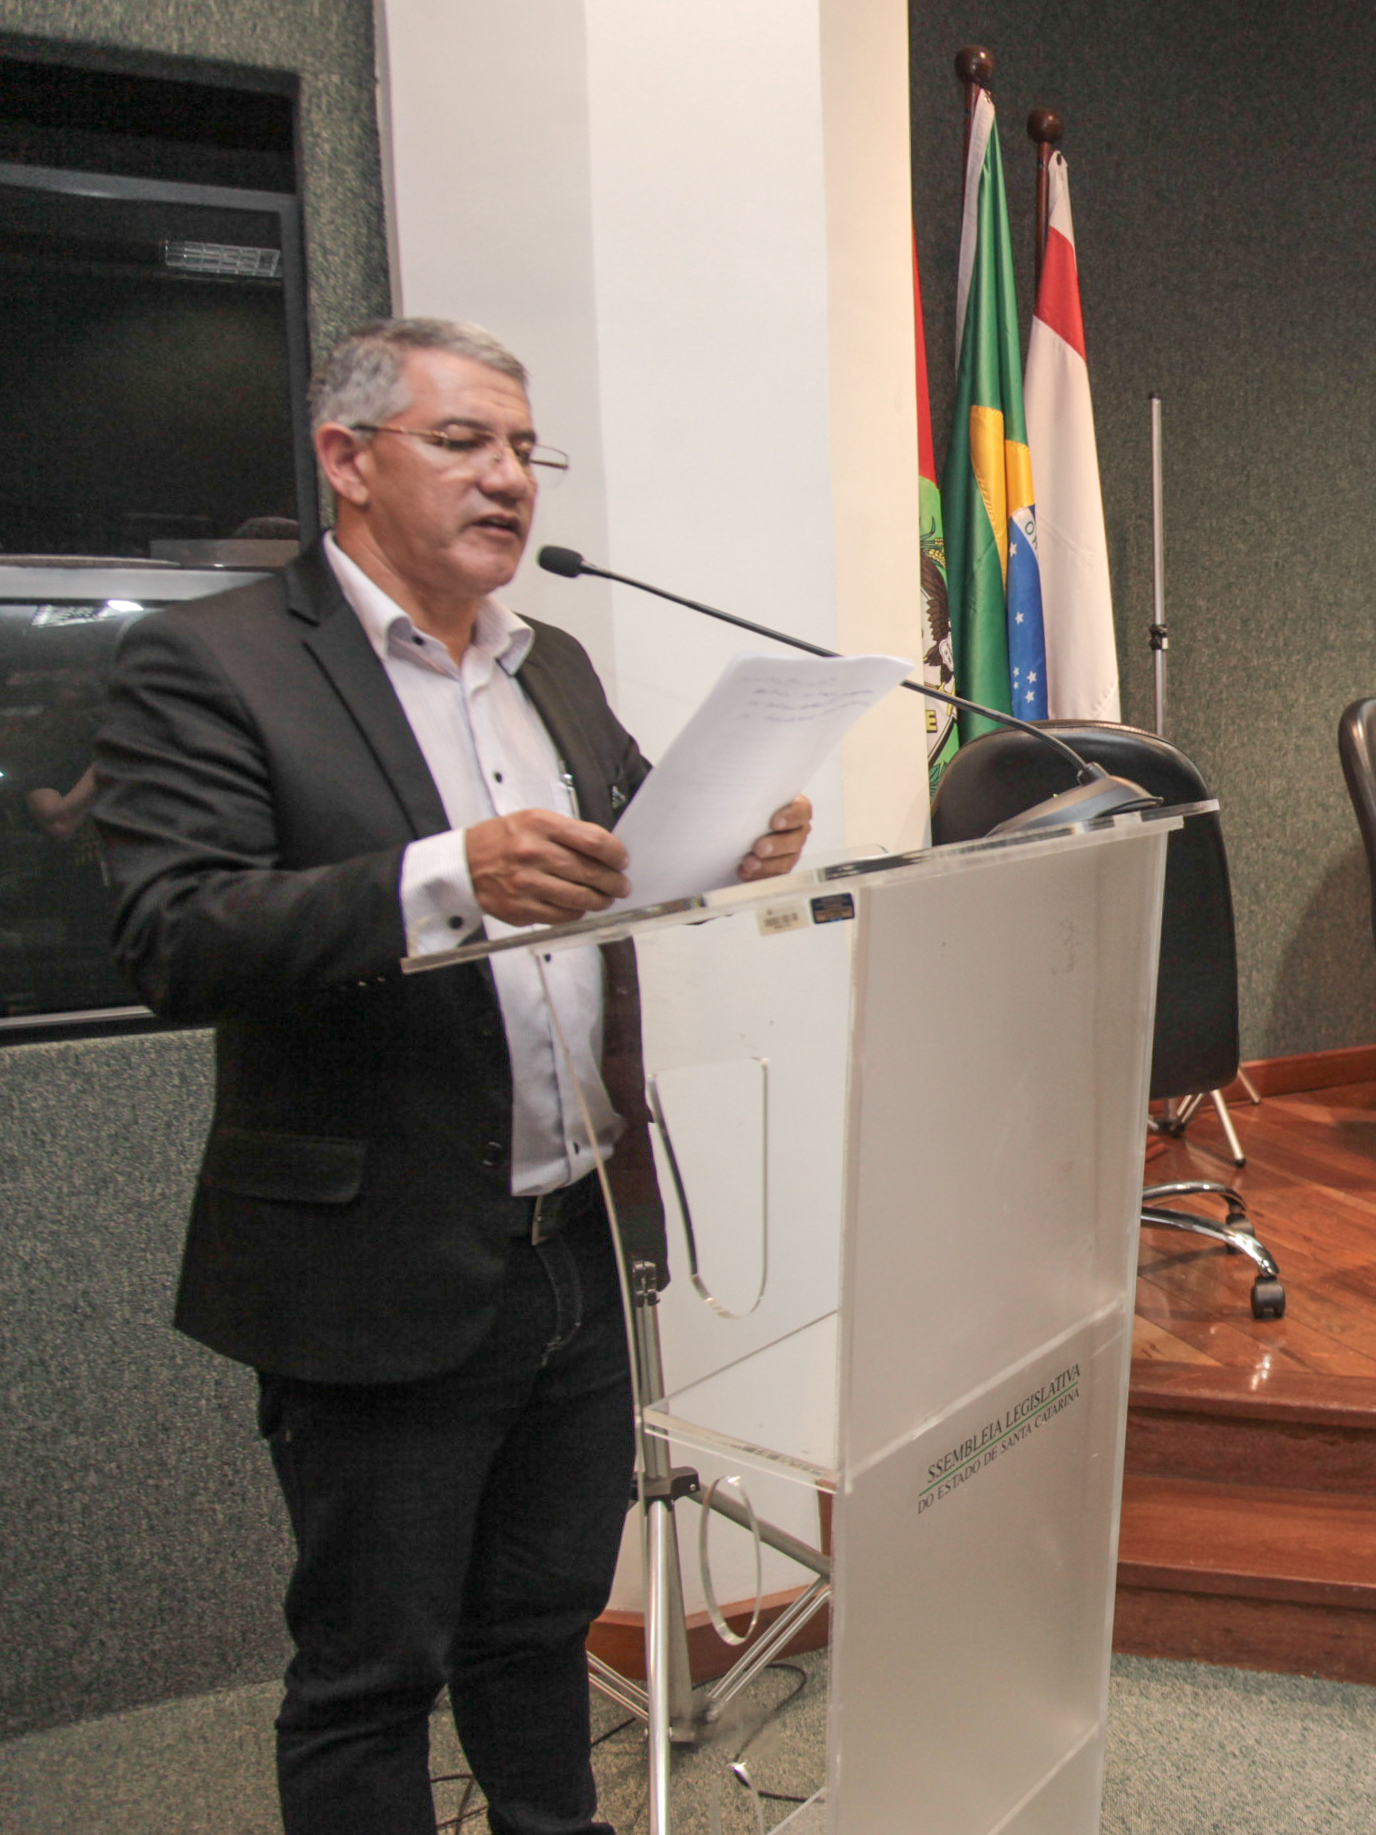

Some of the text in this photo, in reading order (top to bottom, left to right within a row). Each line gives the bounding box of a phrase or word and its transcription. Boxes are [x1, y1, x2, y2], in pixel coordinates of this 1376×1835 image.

[917, 1388, 1080, 1514] DO ESTADO DE SANTA CATARINA
[927, 1363, 1081, 1483] SSEMBLEIA LEGISLATIVA
